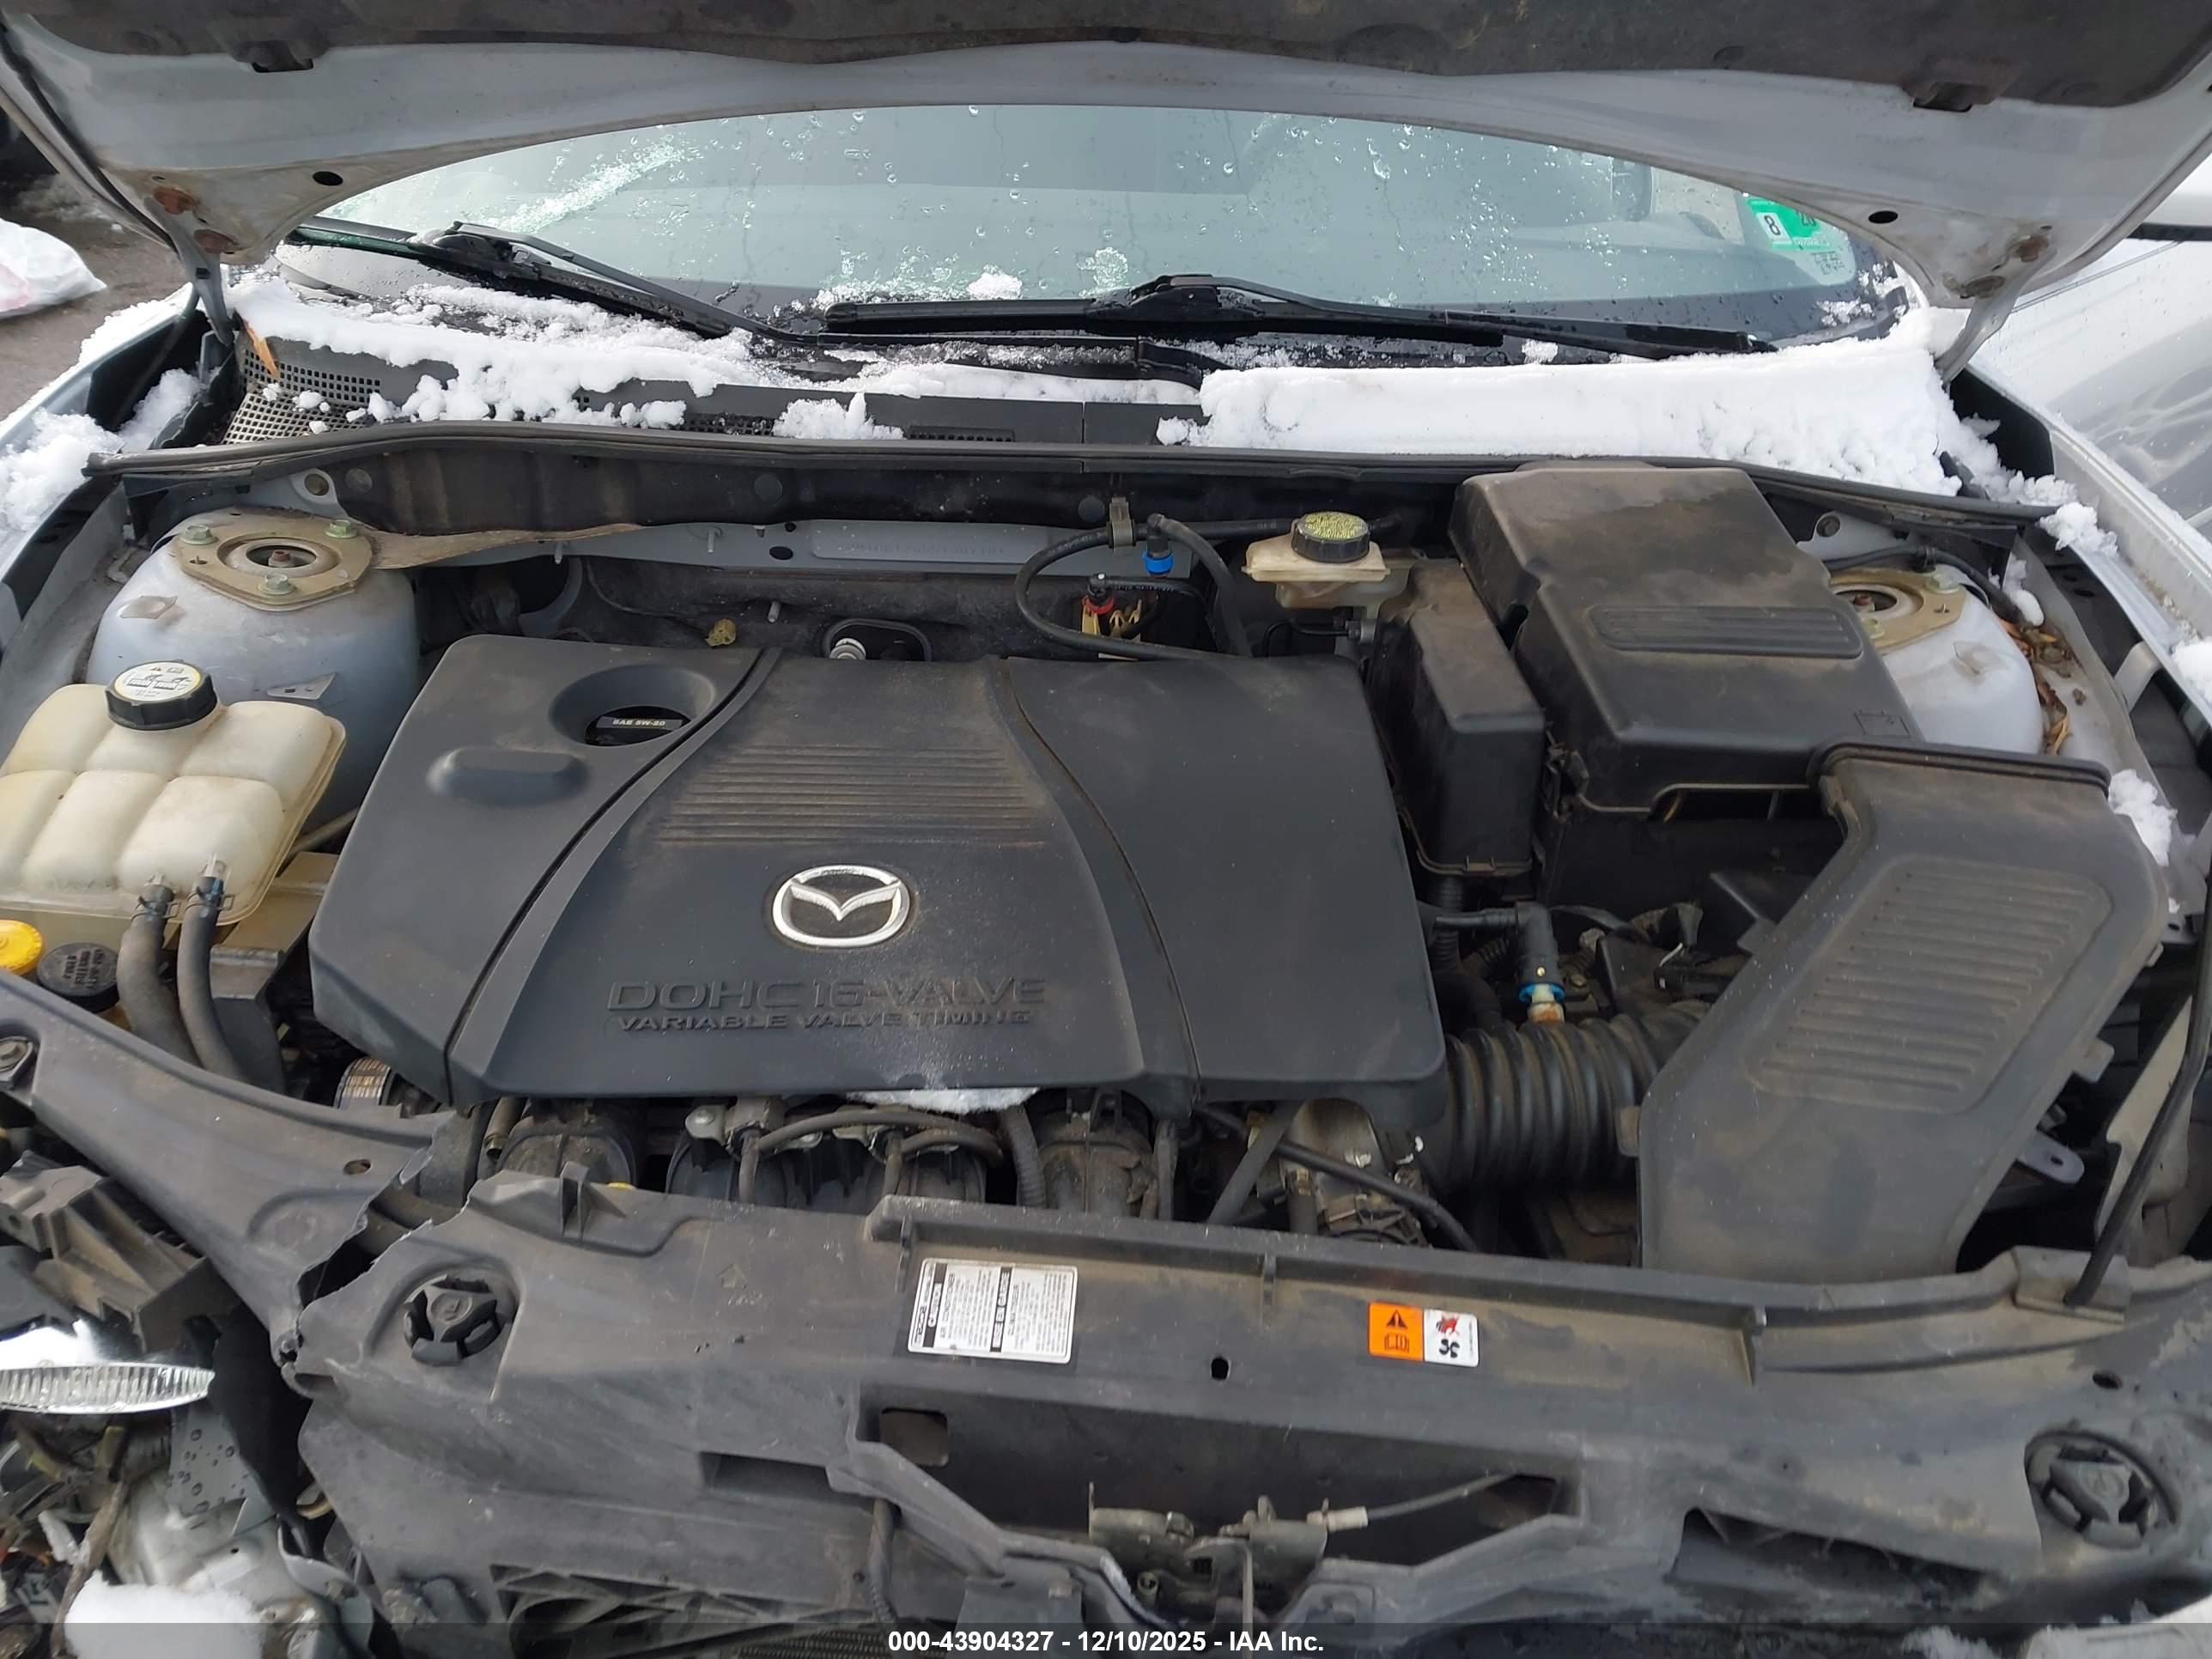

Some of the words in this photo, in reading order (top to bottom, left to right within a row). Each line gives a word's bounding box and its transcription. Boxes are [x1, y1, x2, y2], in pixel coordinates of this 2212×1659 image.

[1763, 215, 1782, 236] 8
[611, 717, 634, 726] SAE
[635, 718, 666, 727] 5W-20
[606, 980, 804, 1012] DOHC
[811, 975, 1046, 1009] 16-VALVE
[616, 1014, 788, 1032] VARIABLE
[798, 1012, 902, 1030] VALVE
[908, 1009, 1031, 1027] TIMING
